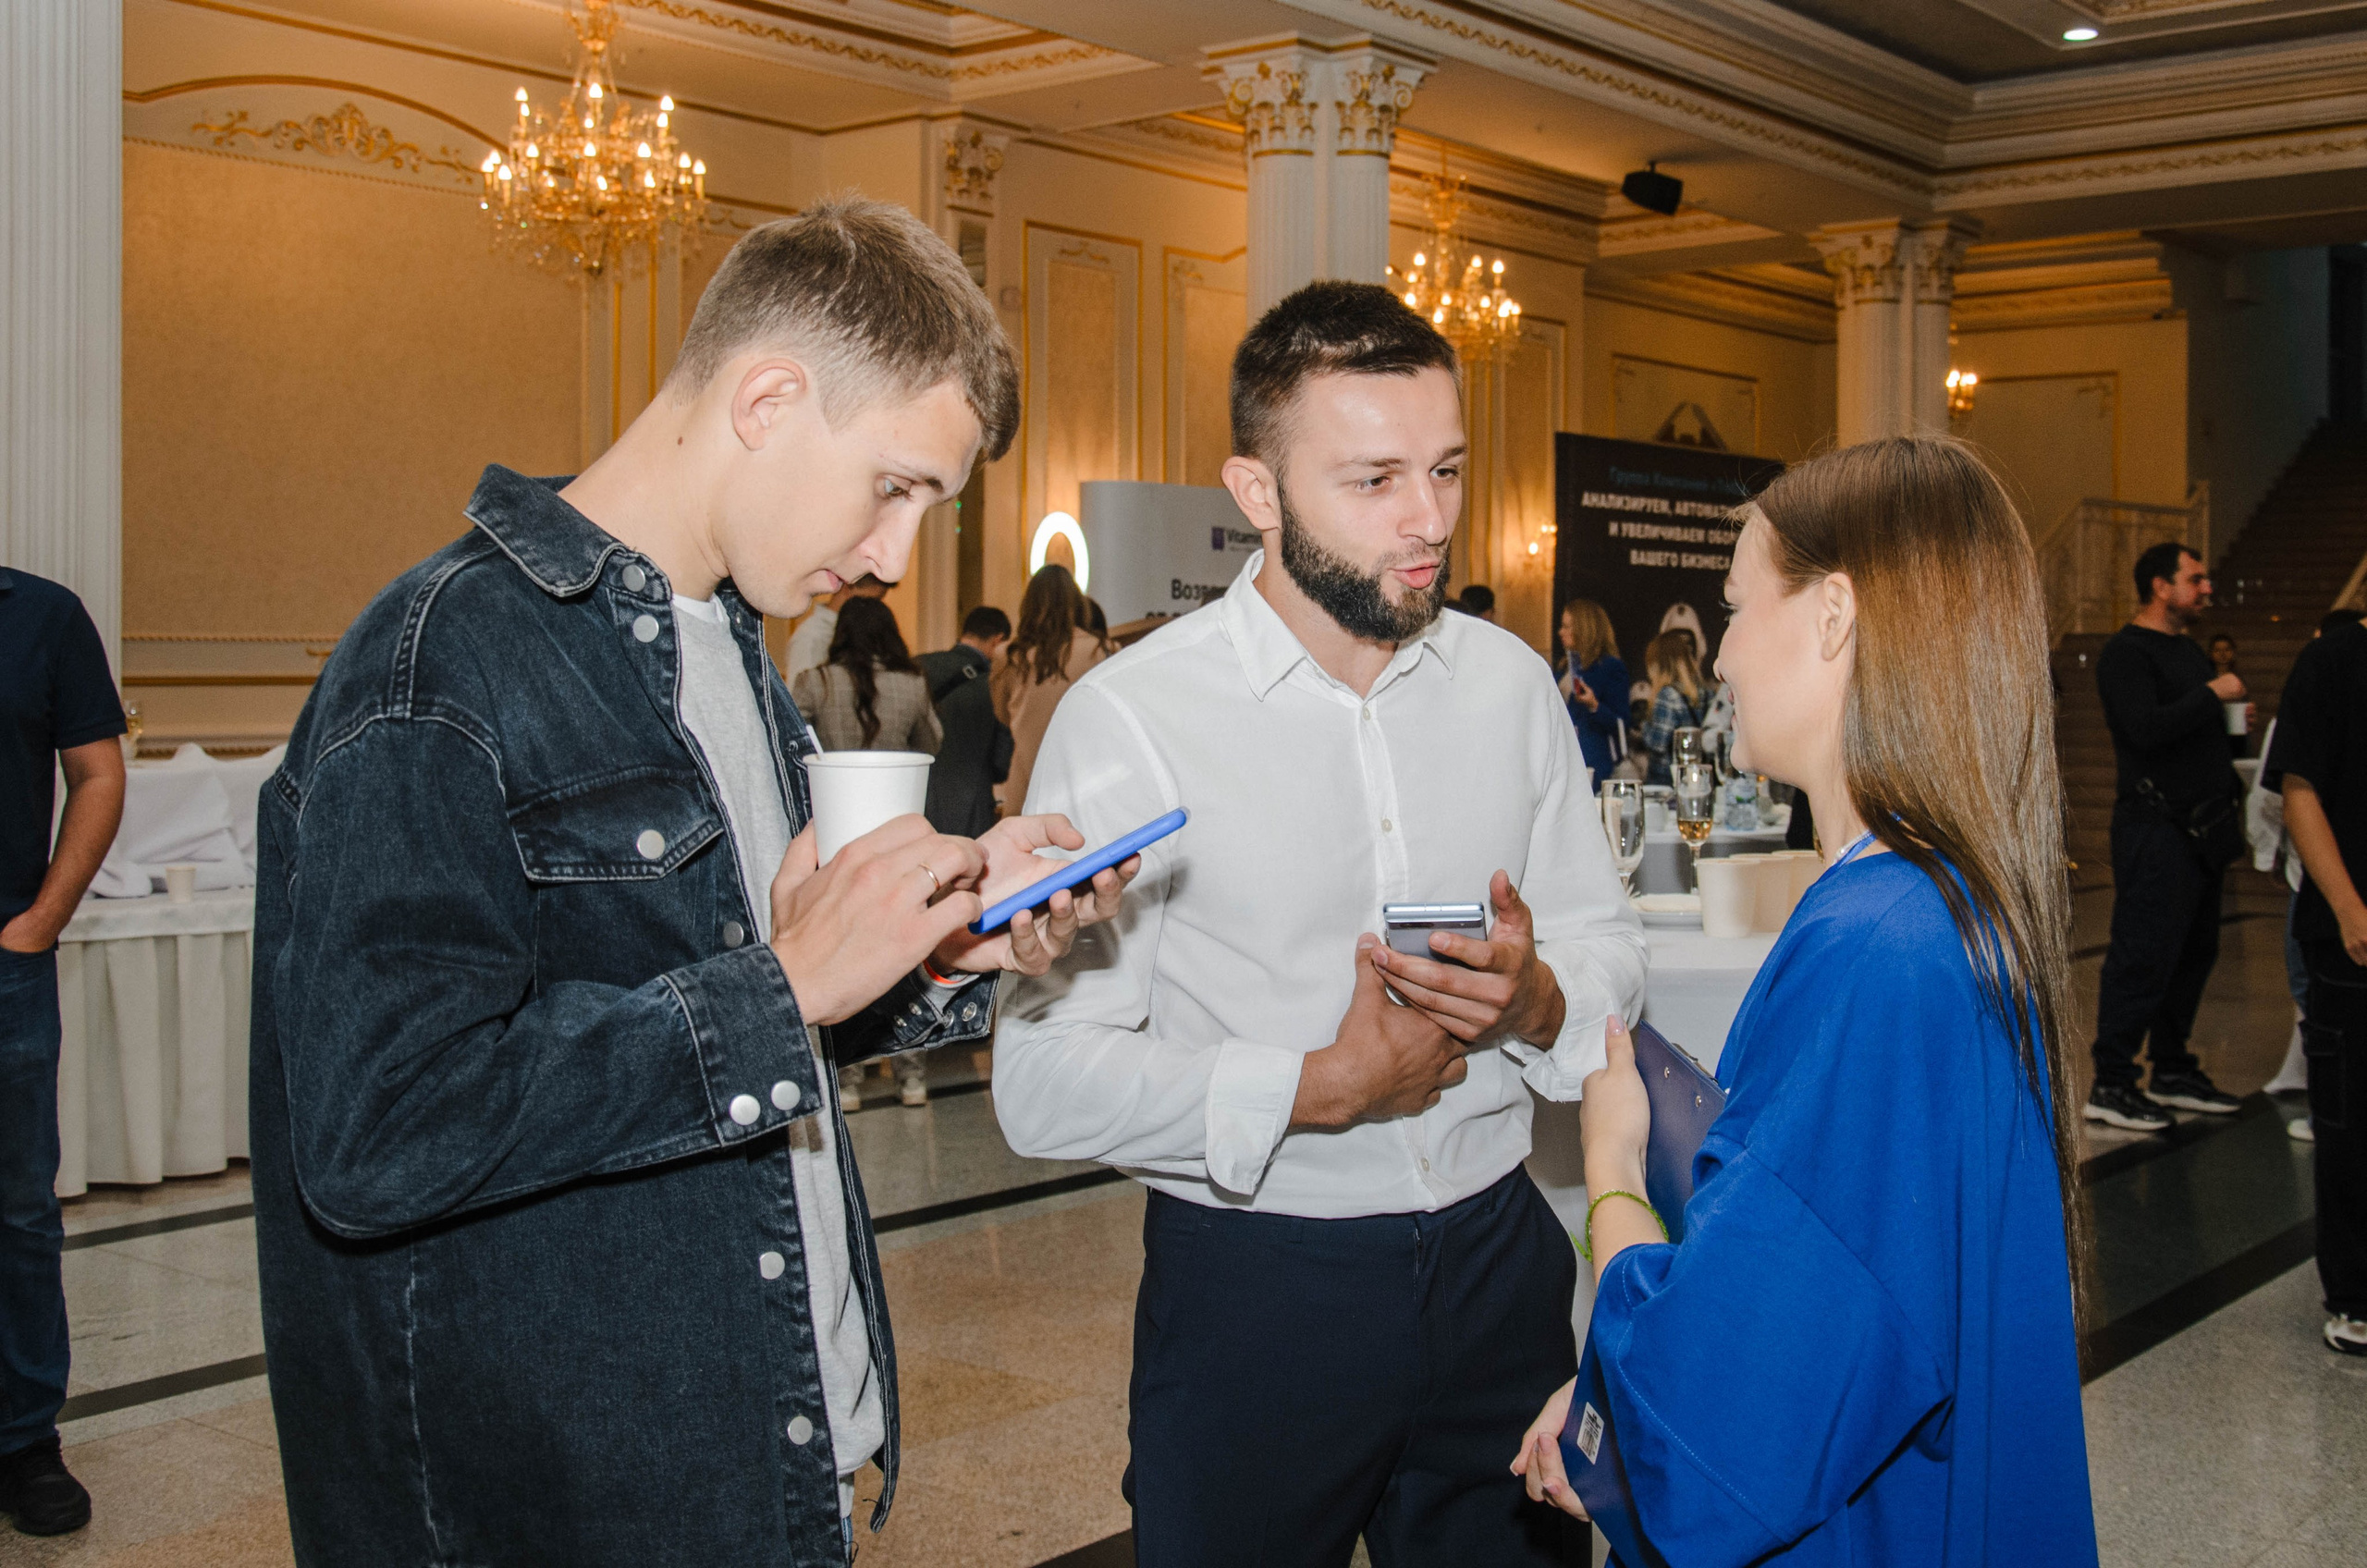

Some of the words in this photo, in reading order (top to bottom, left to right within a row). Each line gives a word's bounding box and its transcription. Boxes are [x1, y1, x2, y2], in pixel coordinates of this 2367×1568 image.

[1581, 491, 1672, 516] АНАЛИЗИРУЕМ,
[1608, 521, 1619, 537] И
[1620, 521, 1706, 544] УВЕЛИЧИВАЕМ
[1629, 549, 1679, 569] ВАШЕГО
